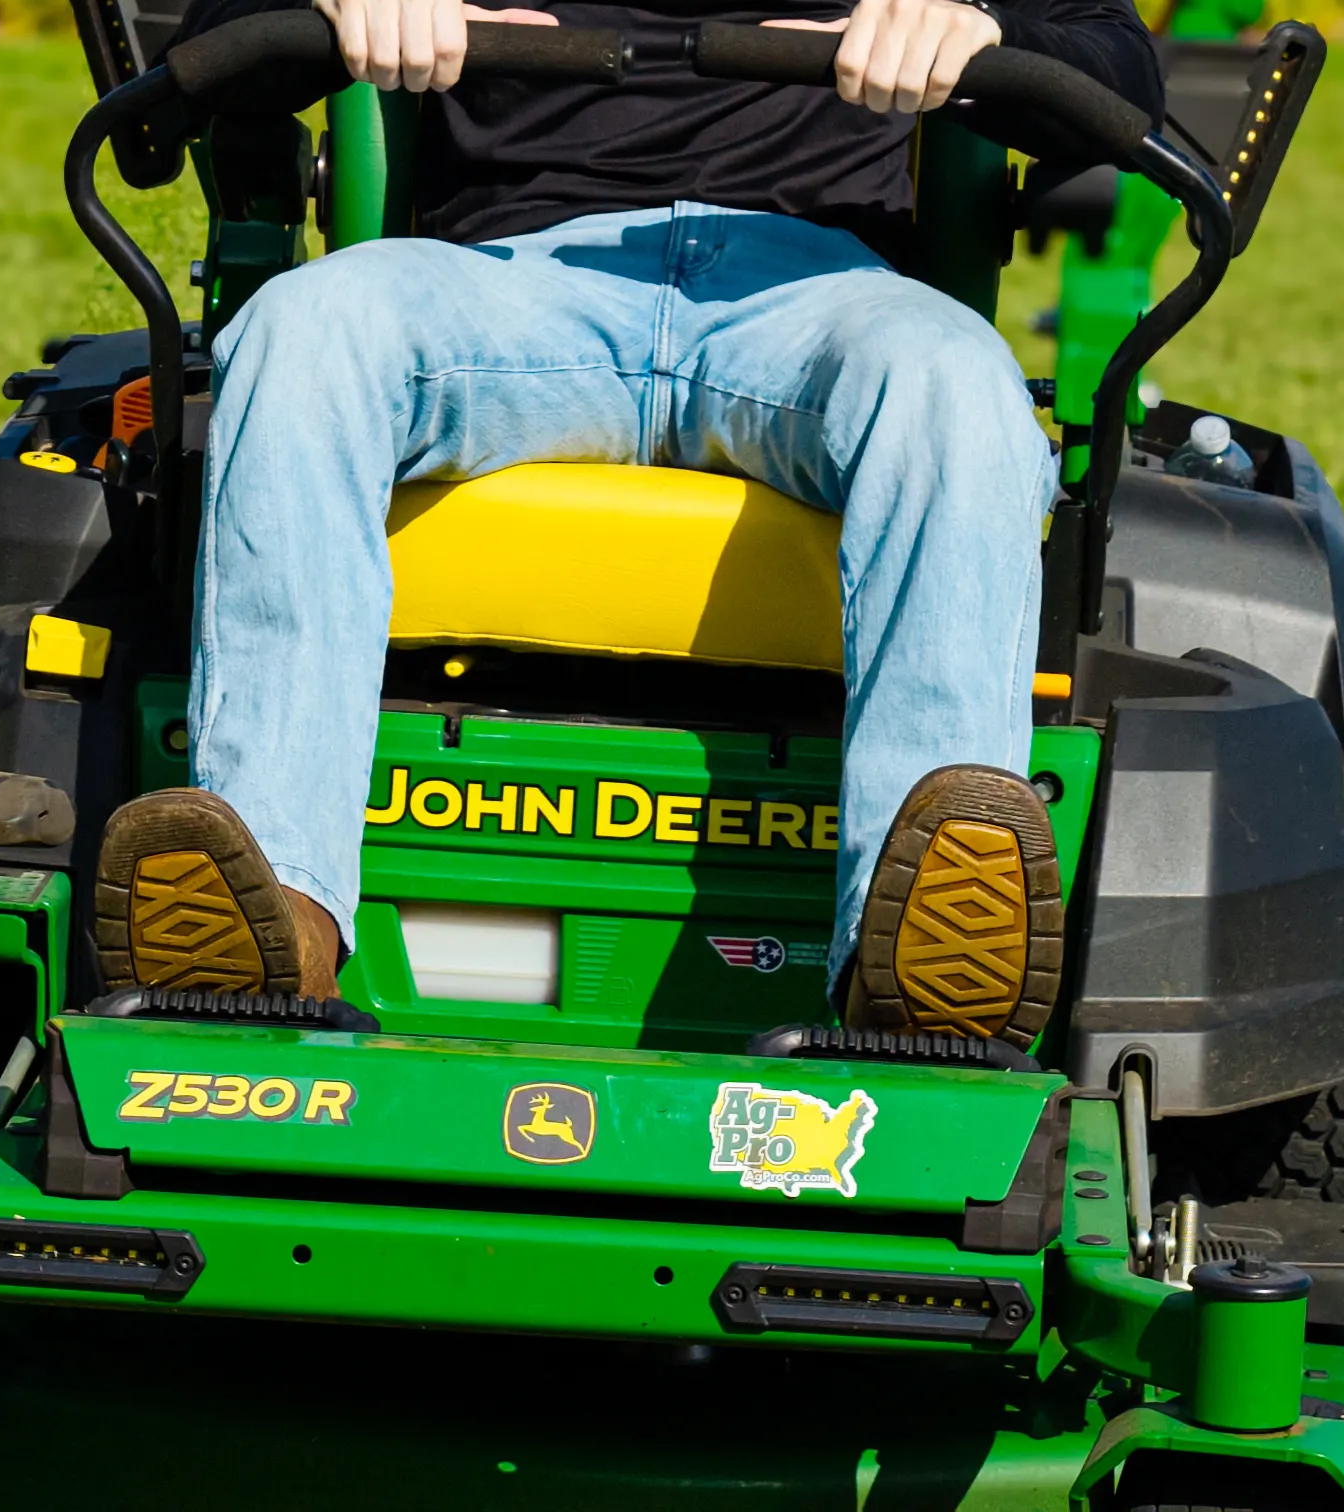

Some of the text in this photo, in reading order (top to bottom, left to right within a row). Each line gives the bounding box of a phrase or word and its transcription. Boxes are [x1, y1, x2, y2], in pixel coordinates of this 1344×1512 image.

[365, 767, 839, 851] JOHN DEERE
[716, 1088, 795, 1135] Ag-
[716, 1126, 795, 1165] Pro
[744, 1170, 831, 1184] AgProCo.com
